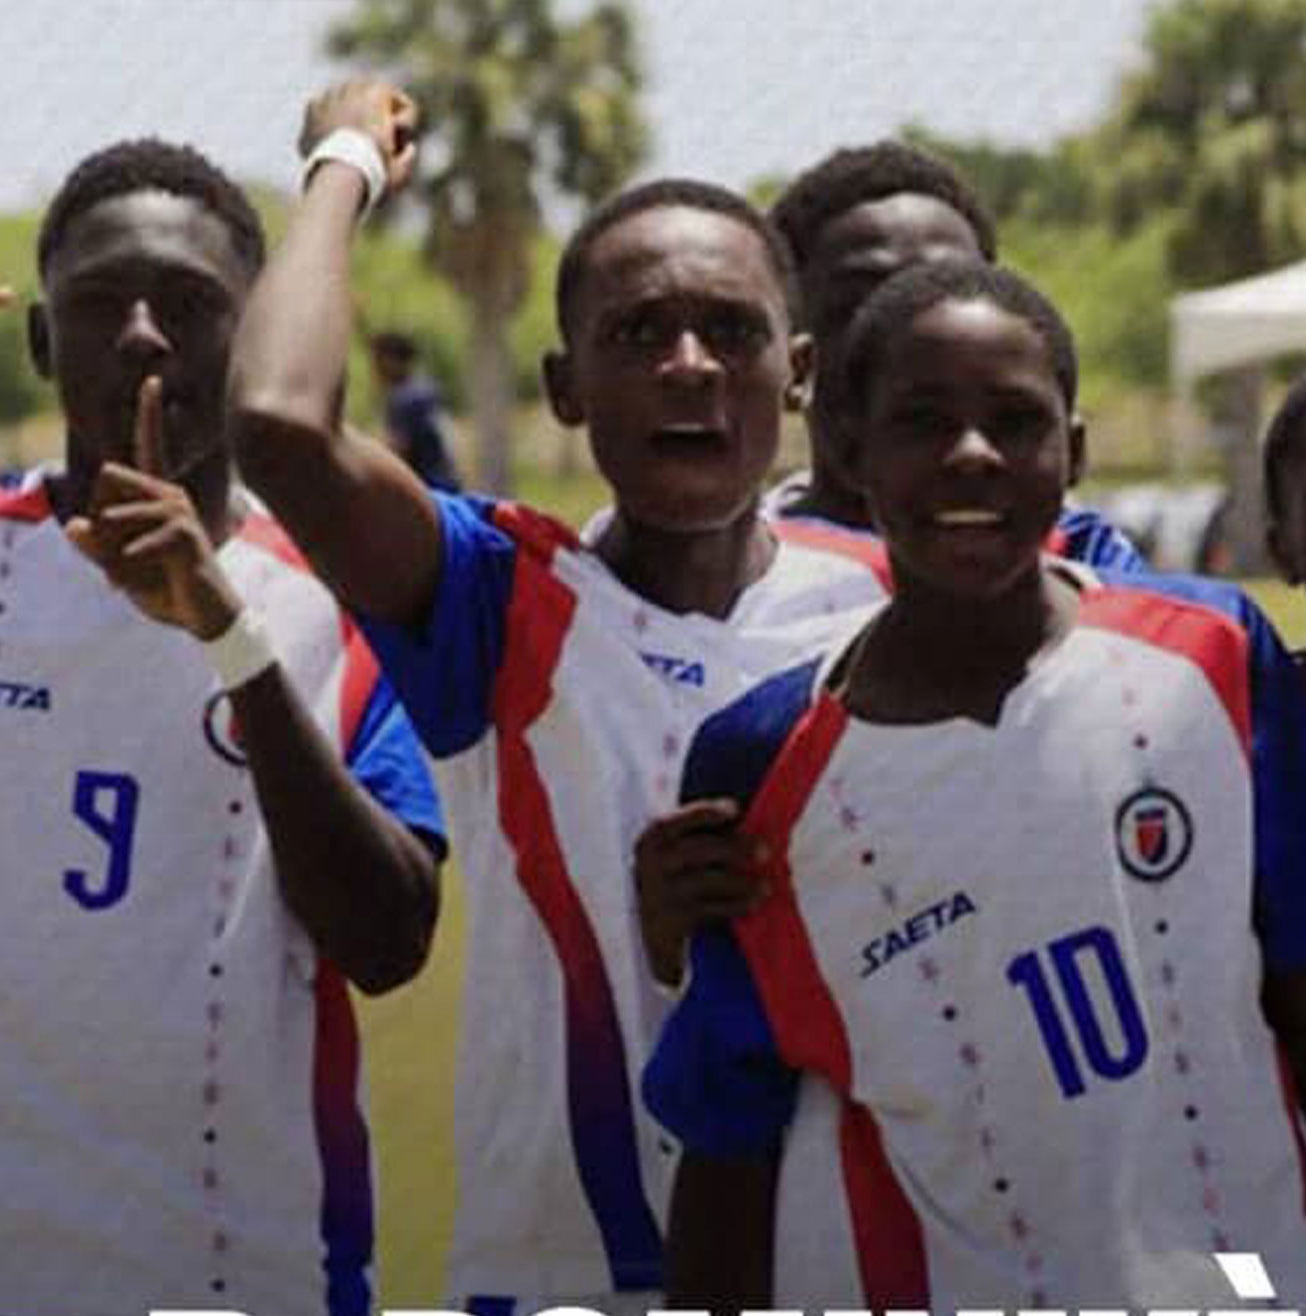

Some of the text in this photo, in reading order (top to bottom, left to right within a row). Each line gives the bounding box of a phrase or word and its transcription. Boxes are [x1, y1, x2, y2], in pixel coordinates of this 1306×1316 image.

[62, 769, 141, 911] 9
[859, 890, 977, 979] SAETA
[1005, 924, 1150, 1100] 10
